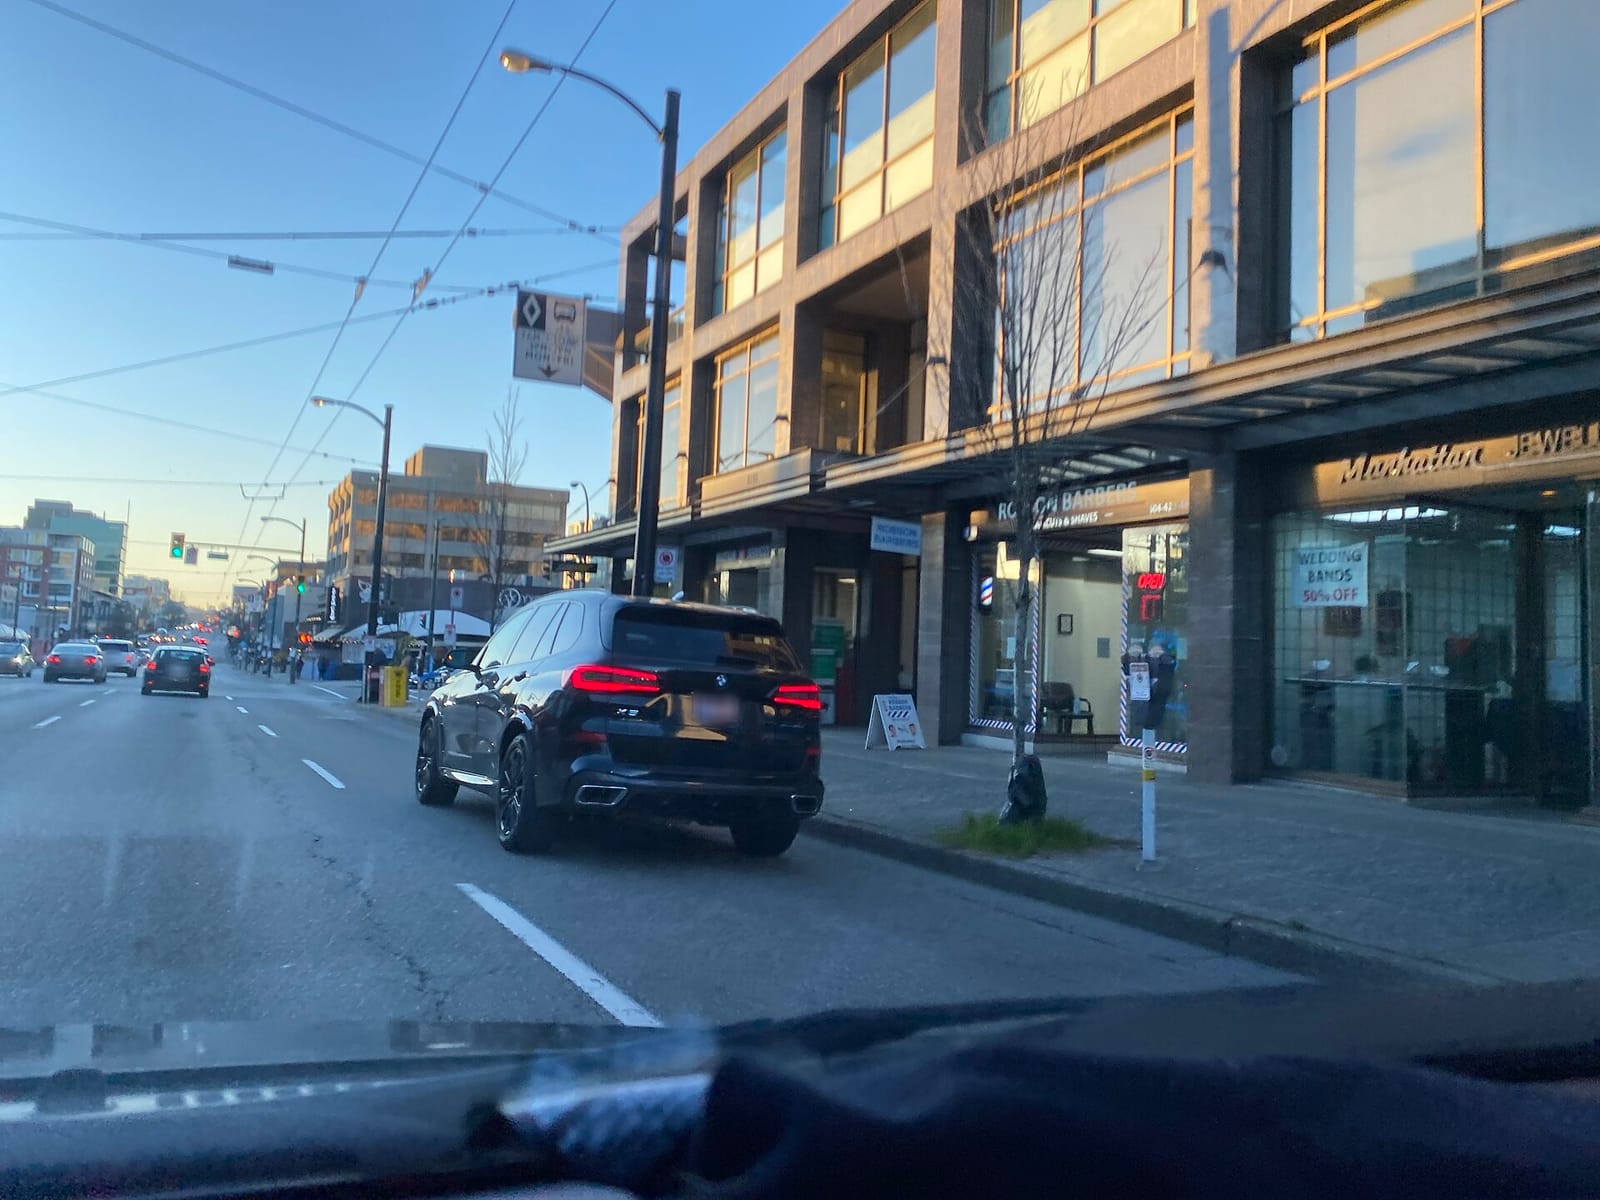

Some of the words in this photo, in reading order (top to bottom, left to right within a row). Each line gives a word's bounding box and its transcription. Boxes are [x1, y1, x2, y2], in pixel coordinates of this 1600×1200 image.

[1340, 445, 1484, 484] Manhattan
[998, 494, 1058, 521] ROON
[1062, 481, 1137, 511] BARBERS
[1299, 548, 1362, 566] WEDDING
[1137, 573, 1165, 590] OPEN
[1308, 567, 1353, 583] BANDS
[1303, 589, 1330, 603] 50%
[1333, 587, 1360, 602] OFF
